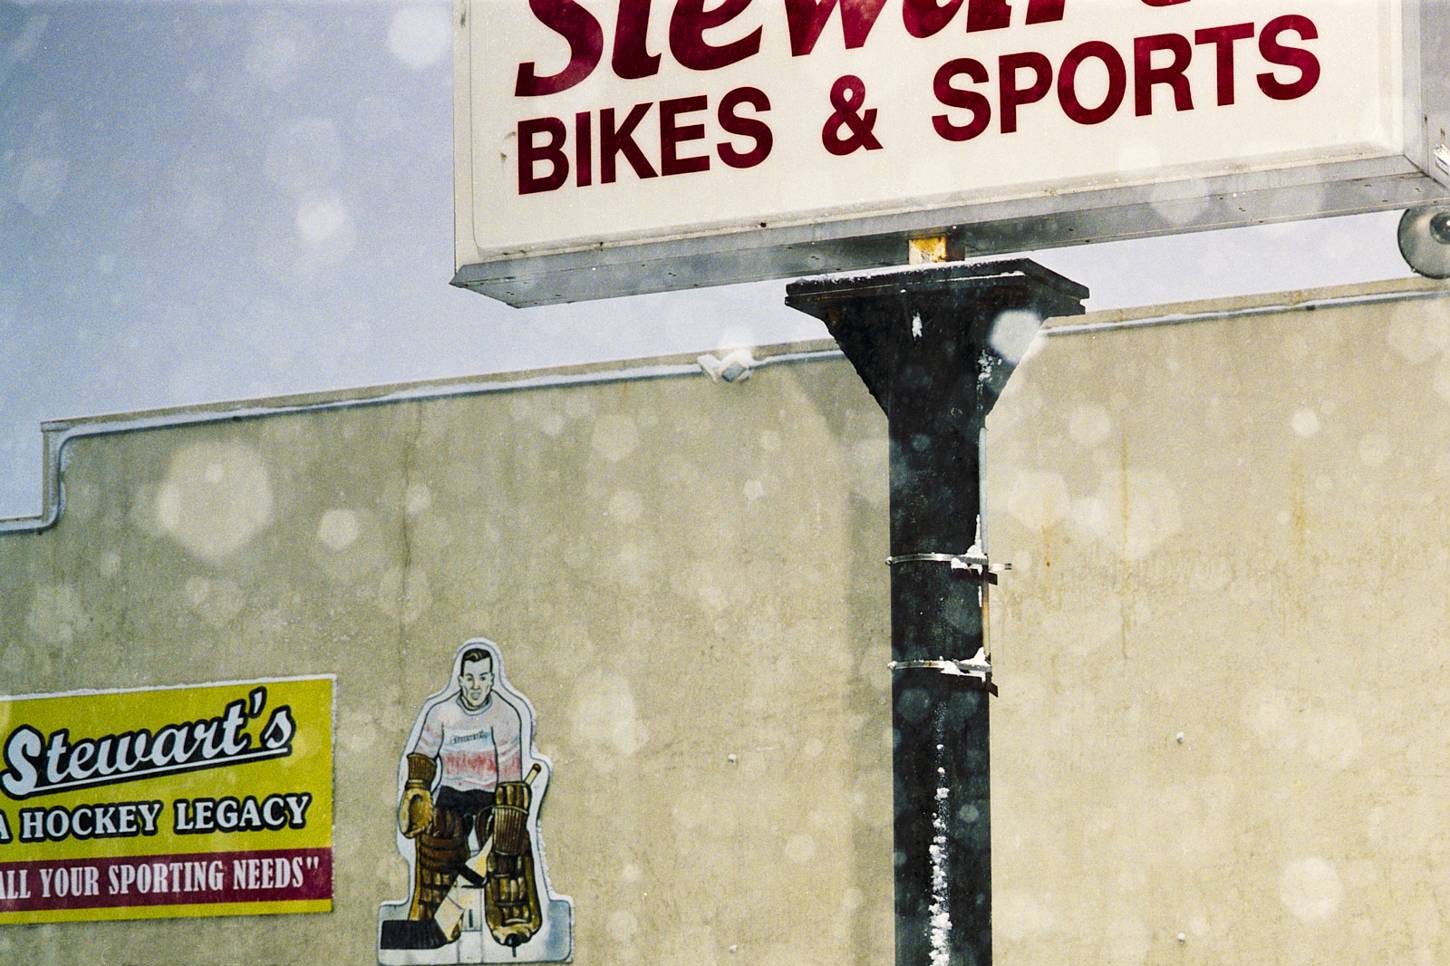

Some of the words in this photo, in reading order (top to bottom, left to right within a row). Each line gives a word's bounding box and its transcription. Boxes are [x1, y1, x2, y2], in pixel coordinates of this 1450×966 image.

[517, 86, 774, 195] BIKES
[821, 74, 884, 156] &
[931, 14, 1321, 142] SPORTS
[1, 690, 293, 796] Stewart's
[21, 803, 162, 839] HOCKEY
[175, 796, 310, 830] LEGACY
[39, 866, 100, 898] YOUR
[108, 860, 225, 896] SPORTING
[232, 856, 320, 890] NEEDS"
